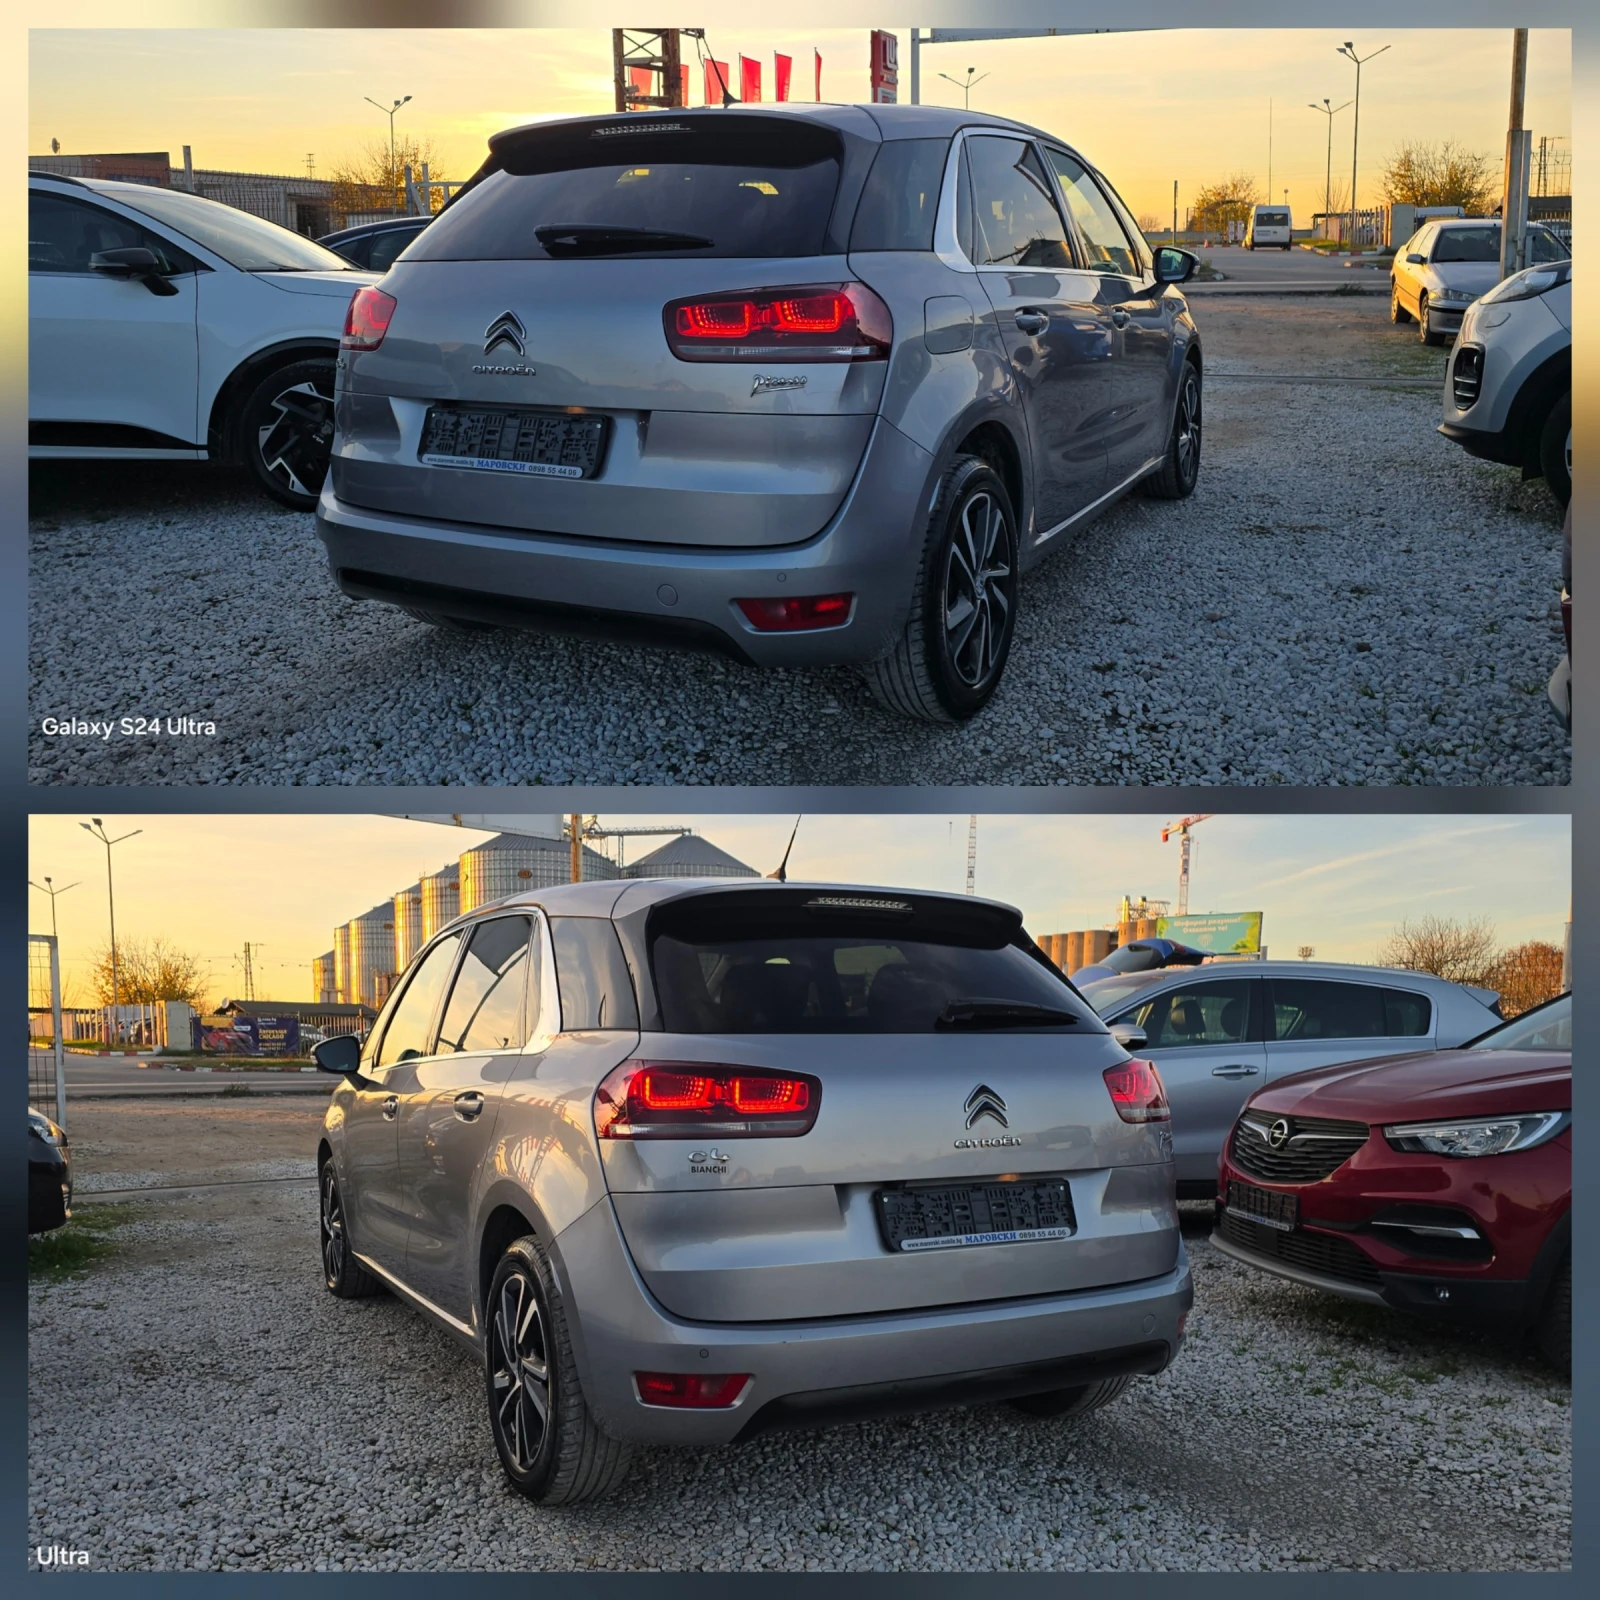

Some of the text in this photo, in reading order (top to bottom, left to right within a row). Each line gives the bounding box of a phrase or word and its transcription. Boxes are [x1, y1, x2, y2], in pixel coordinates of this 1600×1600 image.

[476, 459, 526, 472] МАРОВСКИ
[528, 464, 546, 473] 0898
[547, 466, 556, 474] 55
[557, 467, 567, 475] 44
[688, 1148, 731, 1164] C4
[691, 1165, 727, 1174] BIANCHI
[964, 1231, 1017, 1244] МАРОВСКИ
[1018, 1228, 1067, 1239] 0898 55 44 06
